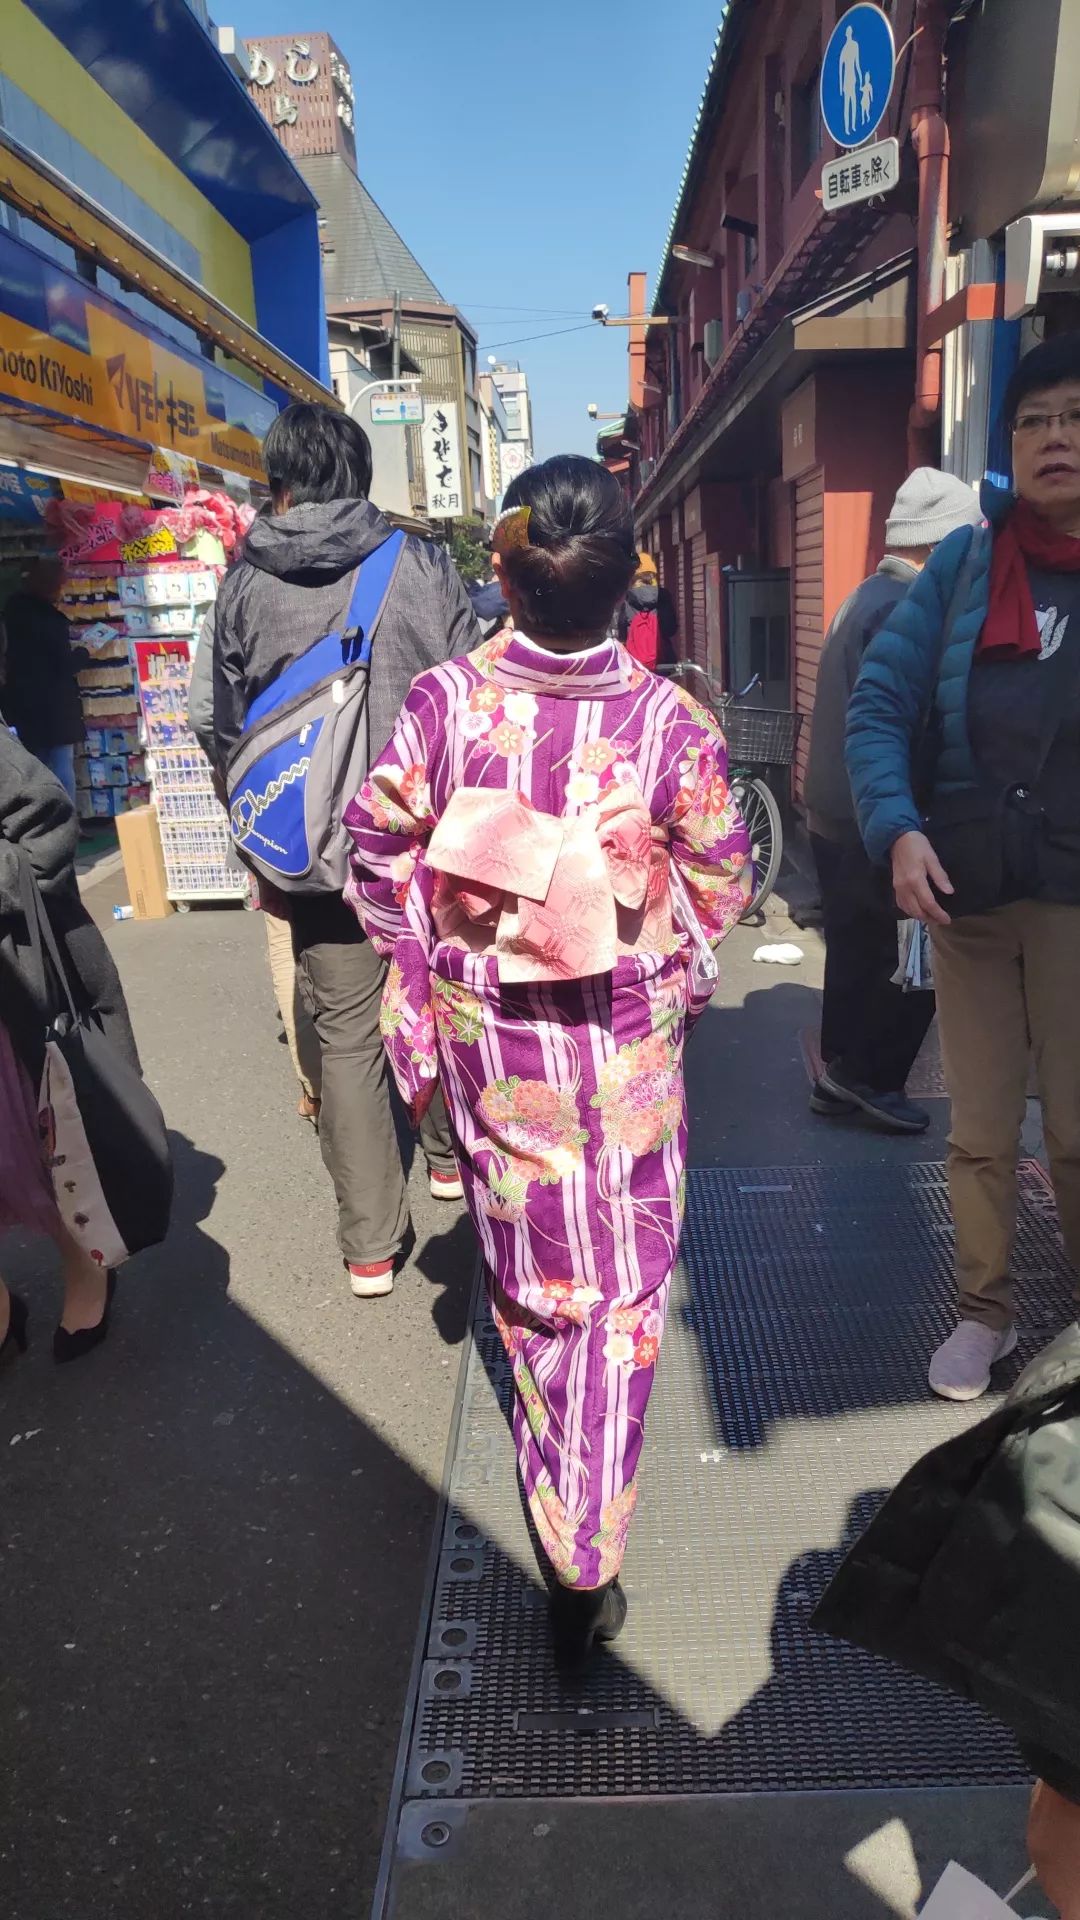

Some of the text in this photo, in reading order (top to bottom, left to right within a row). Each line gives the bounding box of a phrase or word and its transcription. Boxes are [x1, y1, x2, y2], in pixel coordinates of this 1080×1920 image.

[829, 156, 890, 199] 自転車を除く
[40, 354, 94, 407] KiYoshi
[432, 494, 459, 509] 秋月
